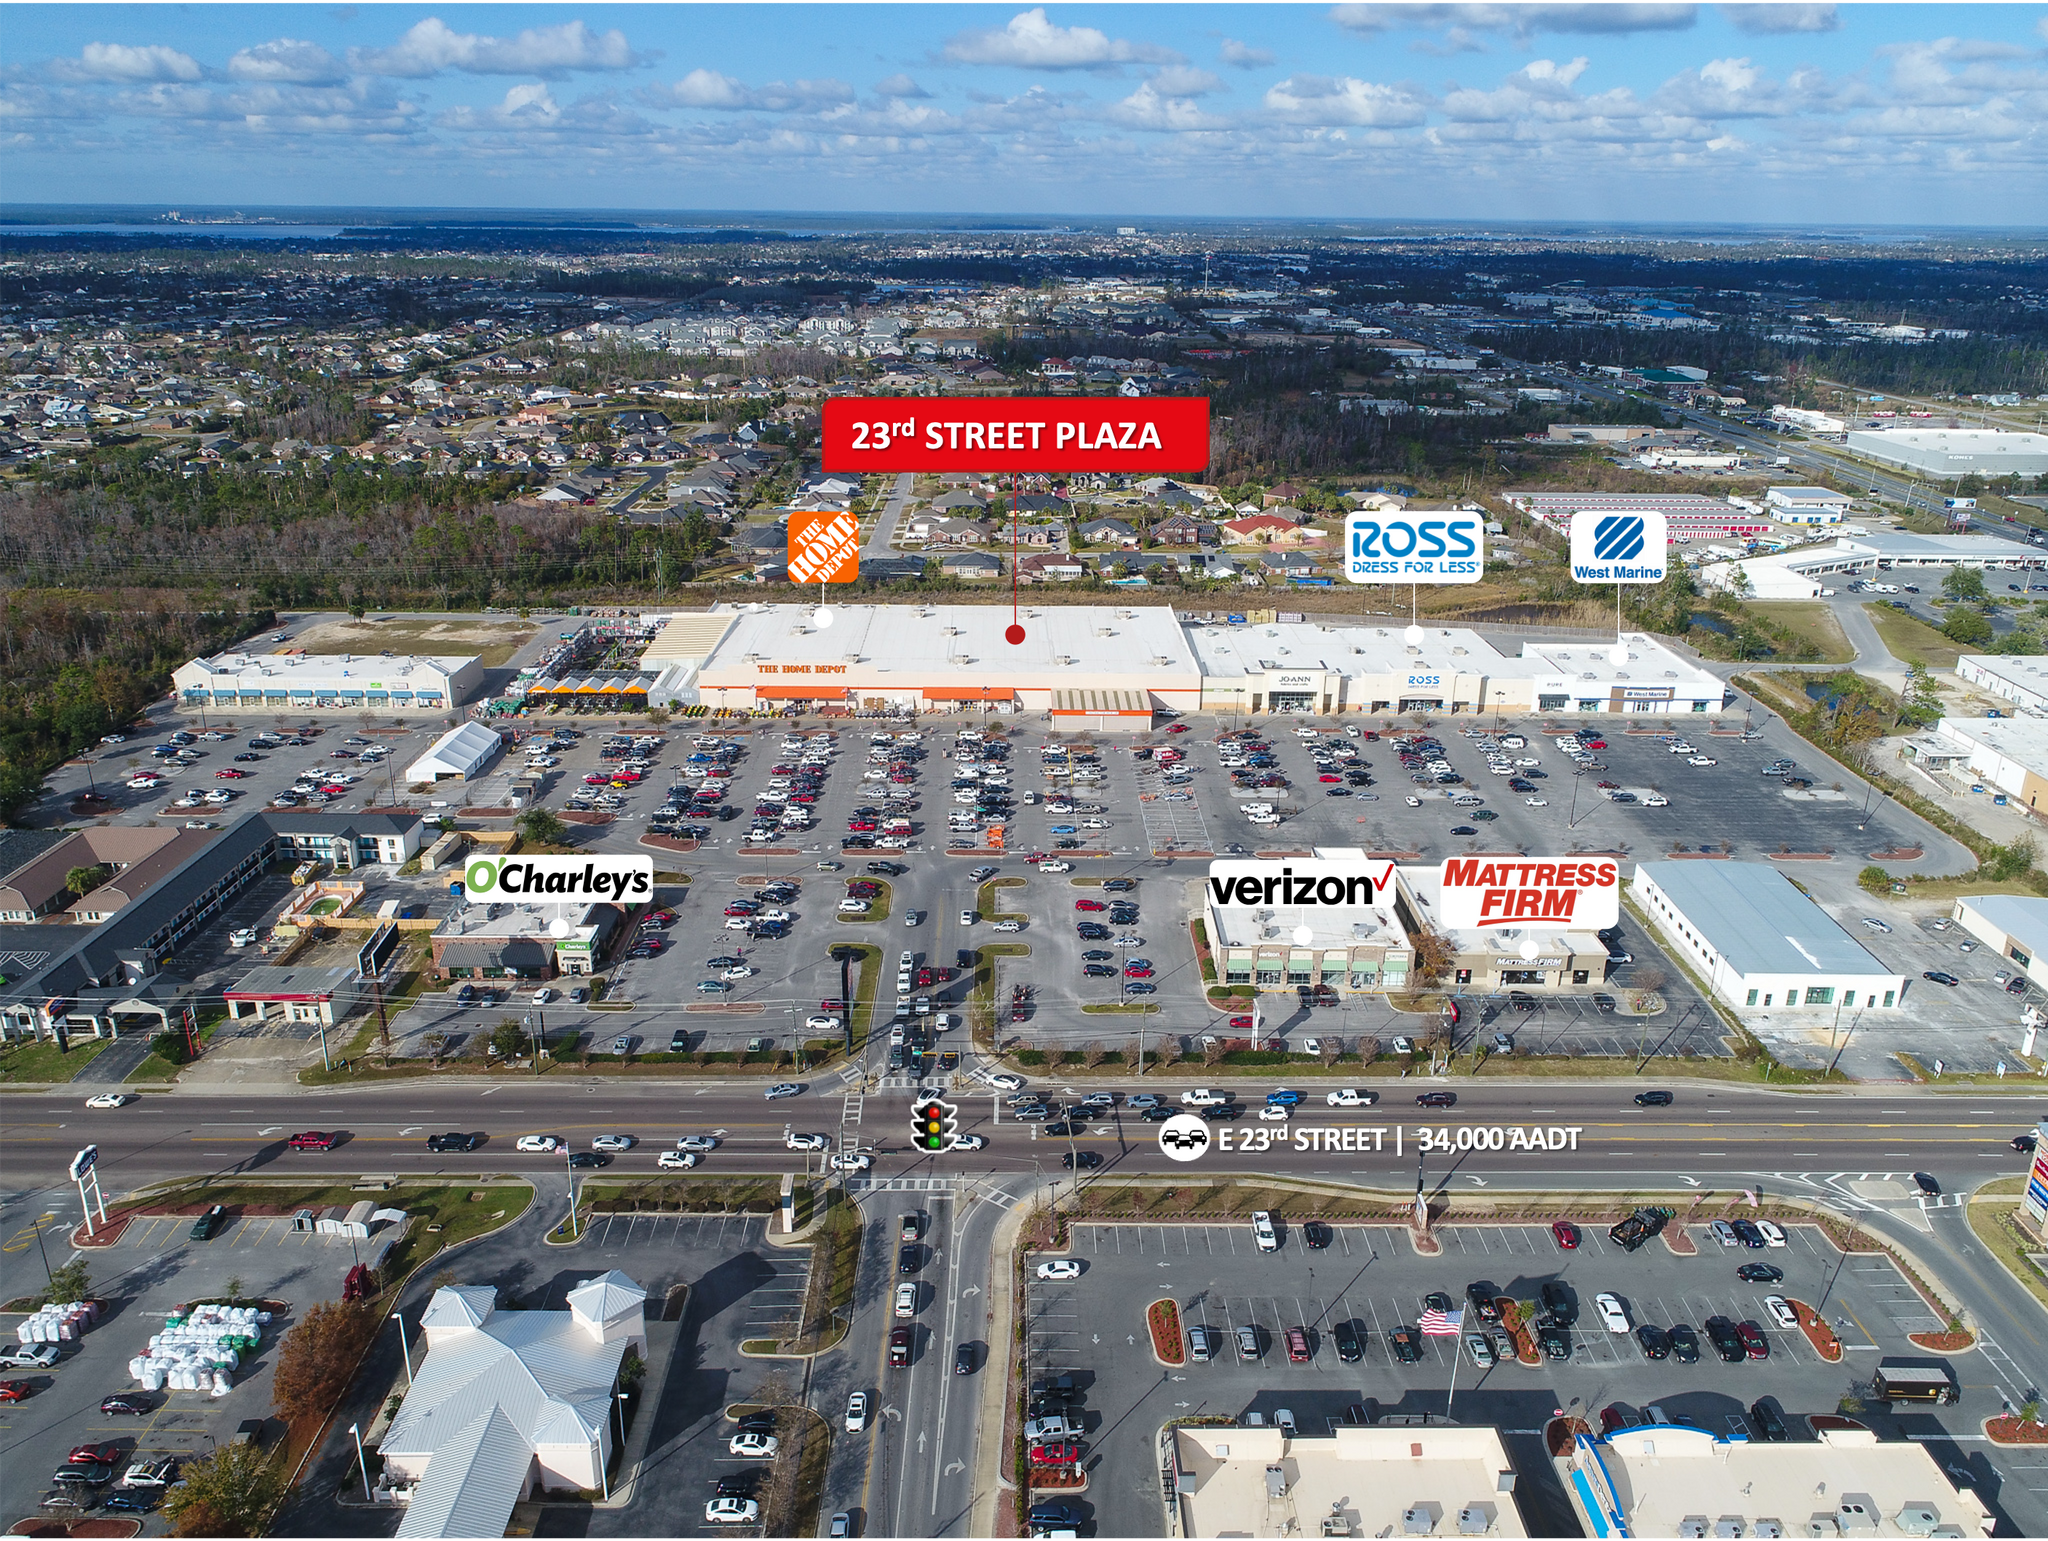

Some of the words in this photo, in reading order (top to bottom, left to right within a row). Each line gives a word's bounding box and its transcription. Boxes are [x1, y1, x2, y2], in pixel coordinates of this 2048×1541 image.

[757, 665, 779, 674] THE
[782, 665, 812, 674] HOME
[814, 665, 848, 674] DEPOT
[1408, 675, 1440, 685] ROSS
[1538, 958, 1562, 967] FIRM
